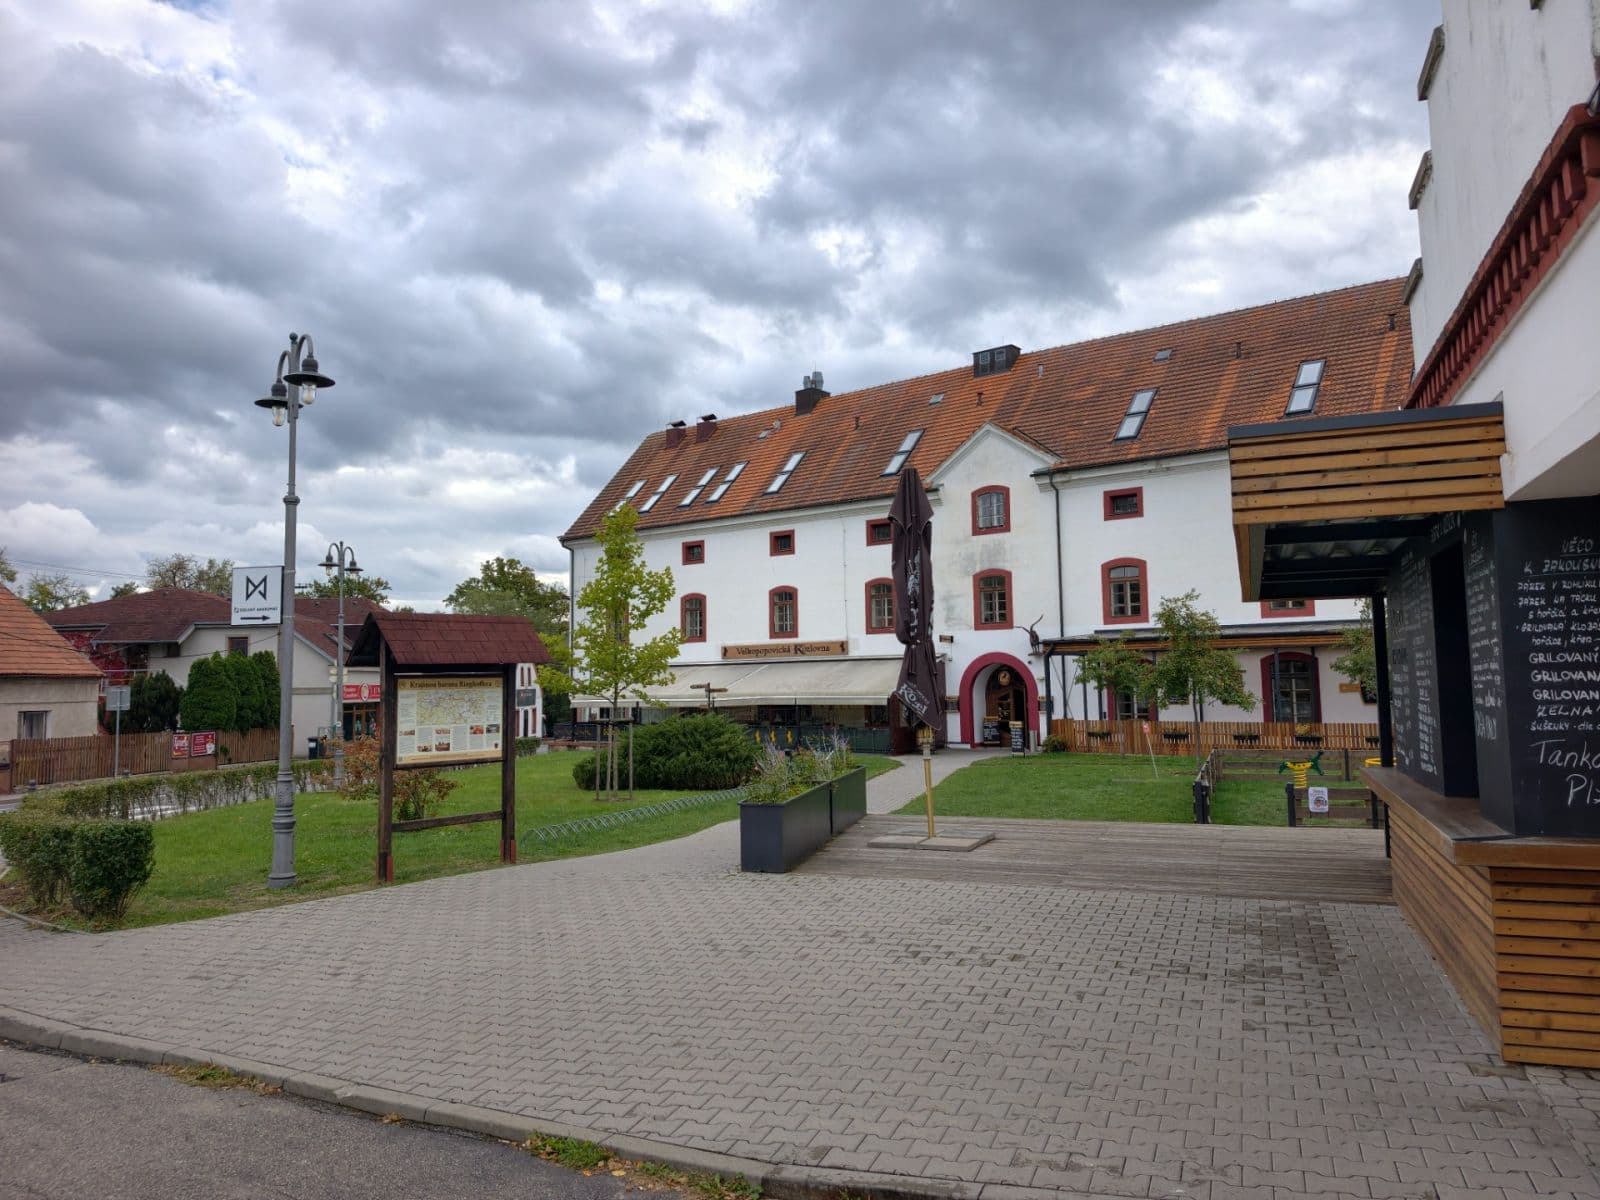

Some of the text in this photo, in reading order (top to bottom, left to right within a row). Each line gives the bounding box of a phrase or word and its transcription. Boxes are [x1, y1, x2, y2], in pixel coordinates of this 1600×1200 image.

[1524, 561, 1533, 574] K
[794, 644, 830, 654] Kozlovna
[1529, 647, 1599, 664] GRILOVANÝ
